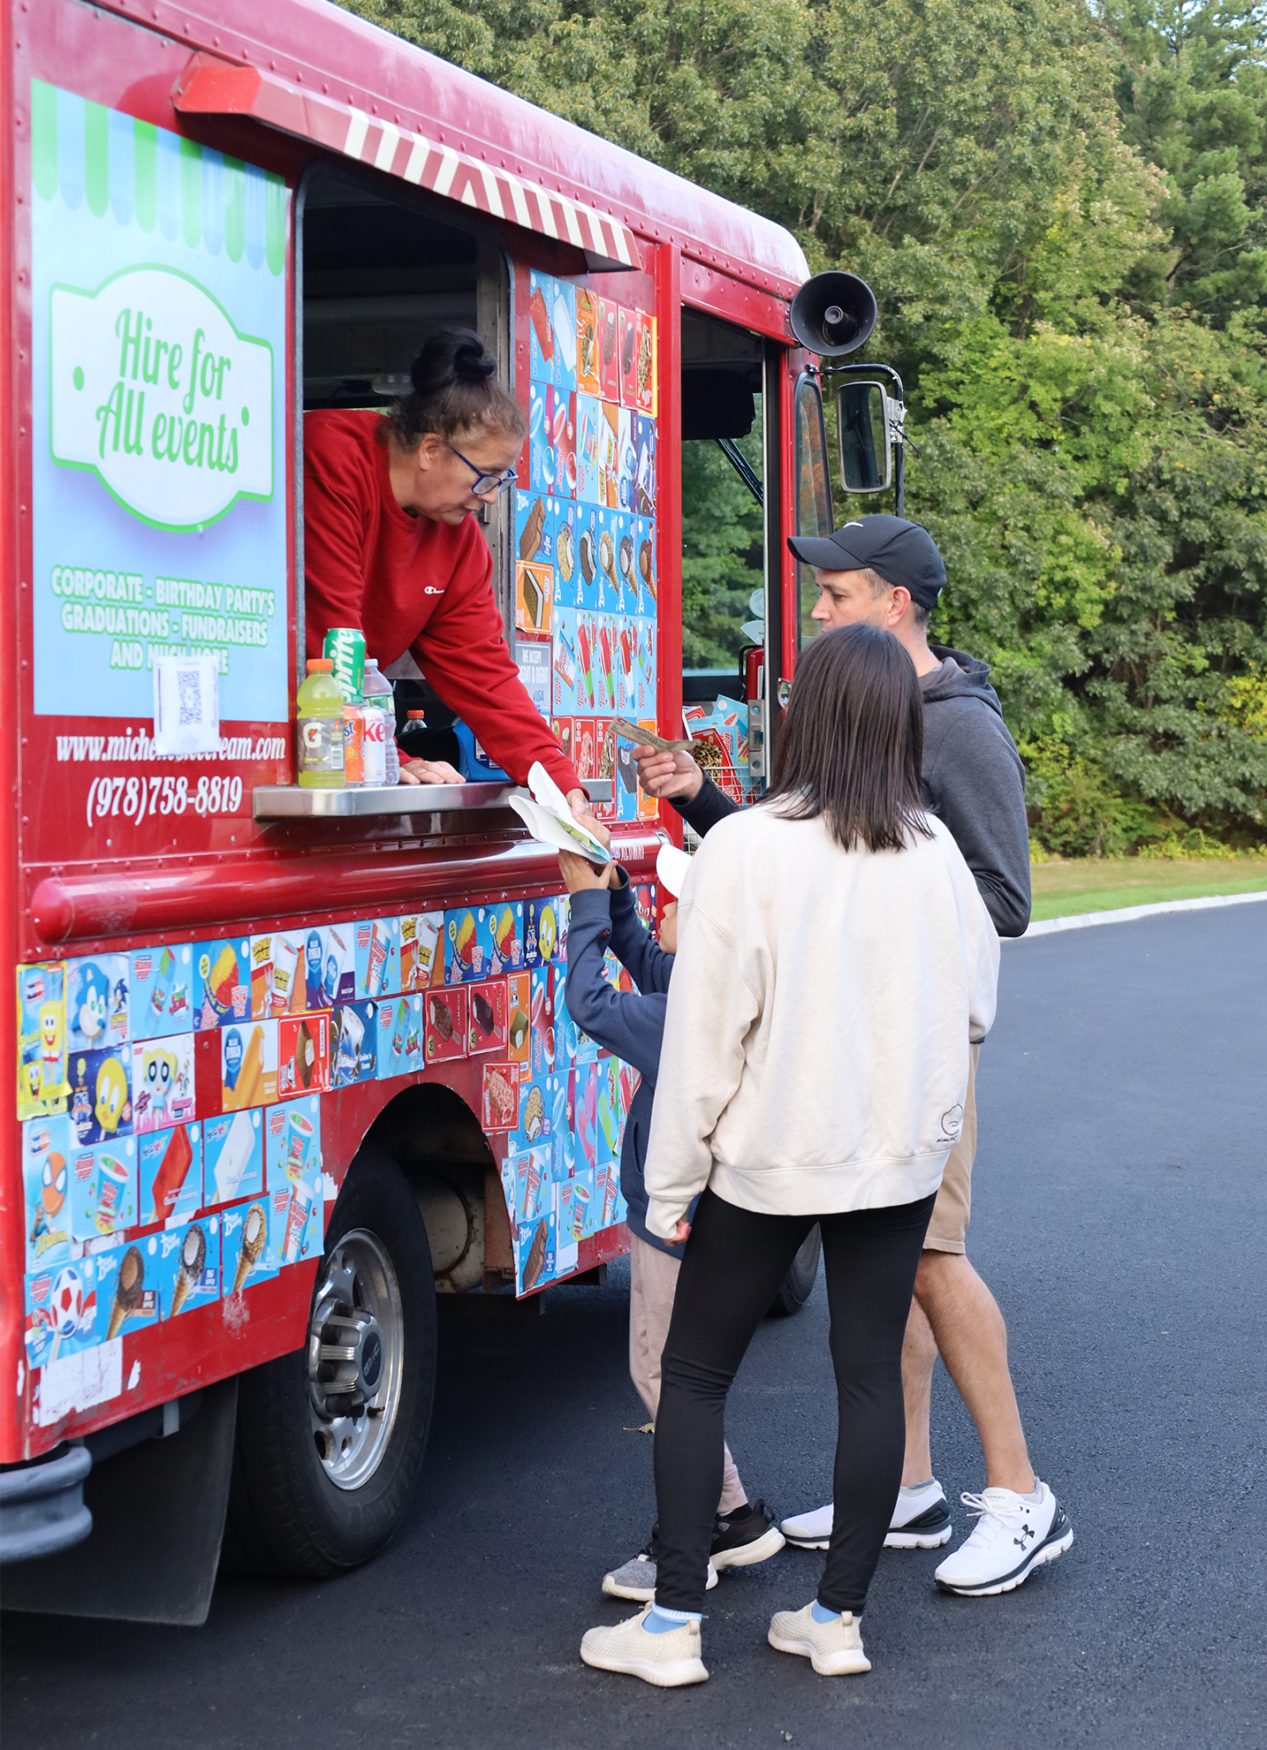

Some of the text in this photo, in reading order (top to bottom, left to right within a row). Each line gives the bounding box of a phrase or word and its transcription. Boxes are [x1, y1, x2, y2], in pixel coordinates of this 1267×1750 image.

[115, 307, 232, 416] Hire for
[95, 380, 239, 474] All events
[51, 564, 143, 604] CORPORATE
[155, 576, 223, 612] BIRTHDAY
[224, 584, 275, 618] PARTY'S
[61, 602, 170, 639] GRADUATIONS
[181, 611, 268, 648] FUNDRAISERS
[109, 639, 143, 670] AND
[364, 715, 385, 742] ke
[86, 775, 243, 828] (978)758-8819
